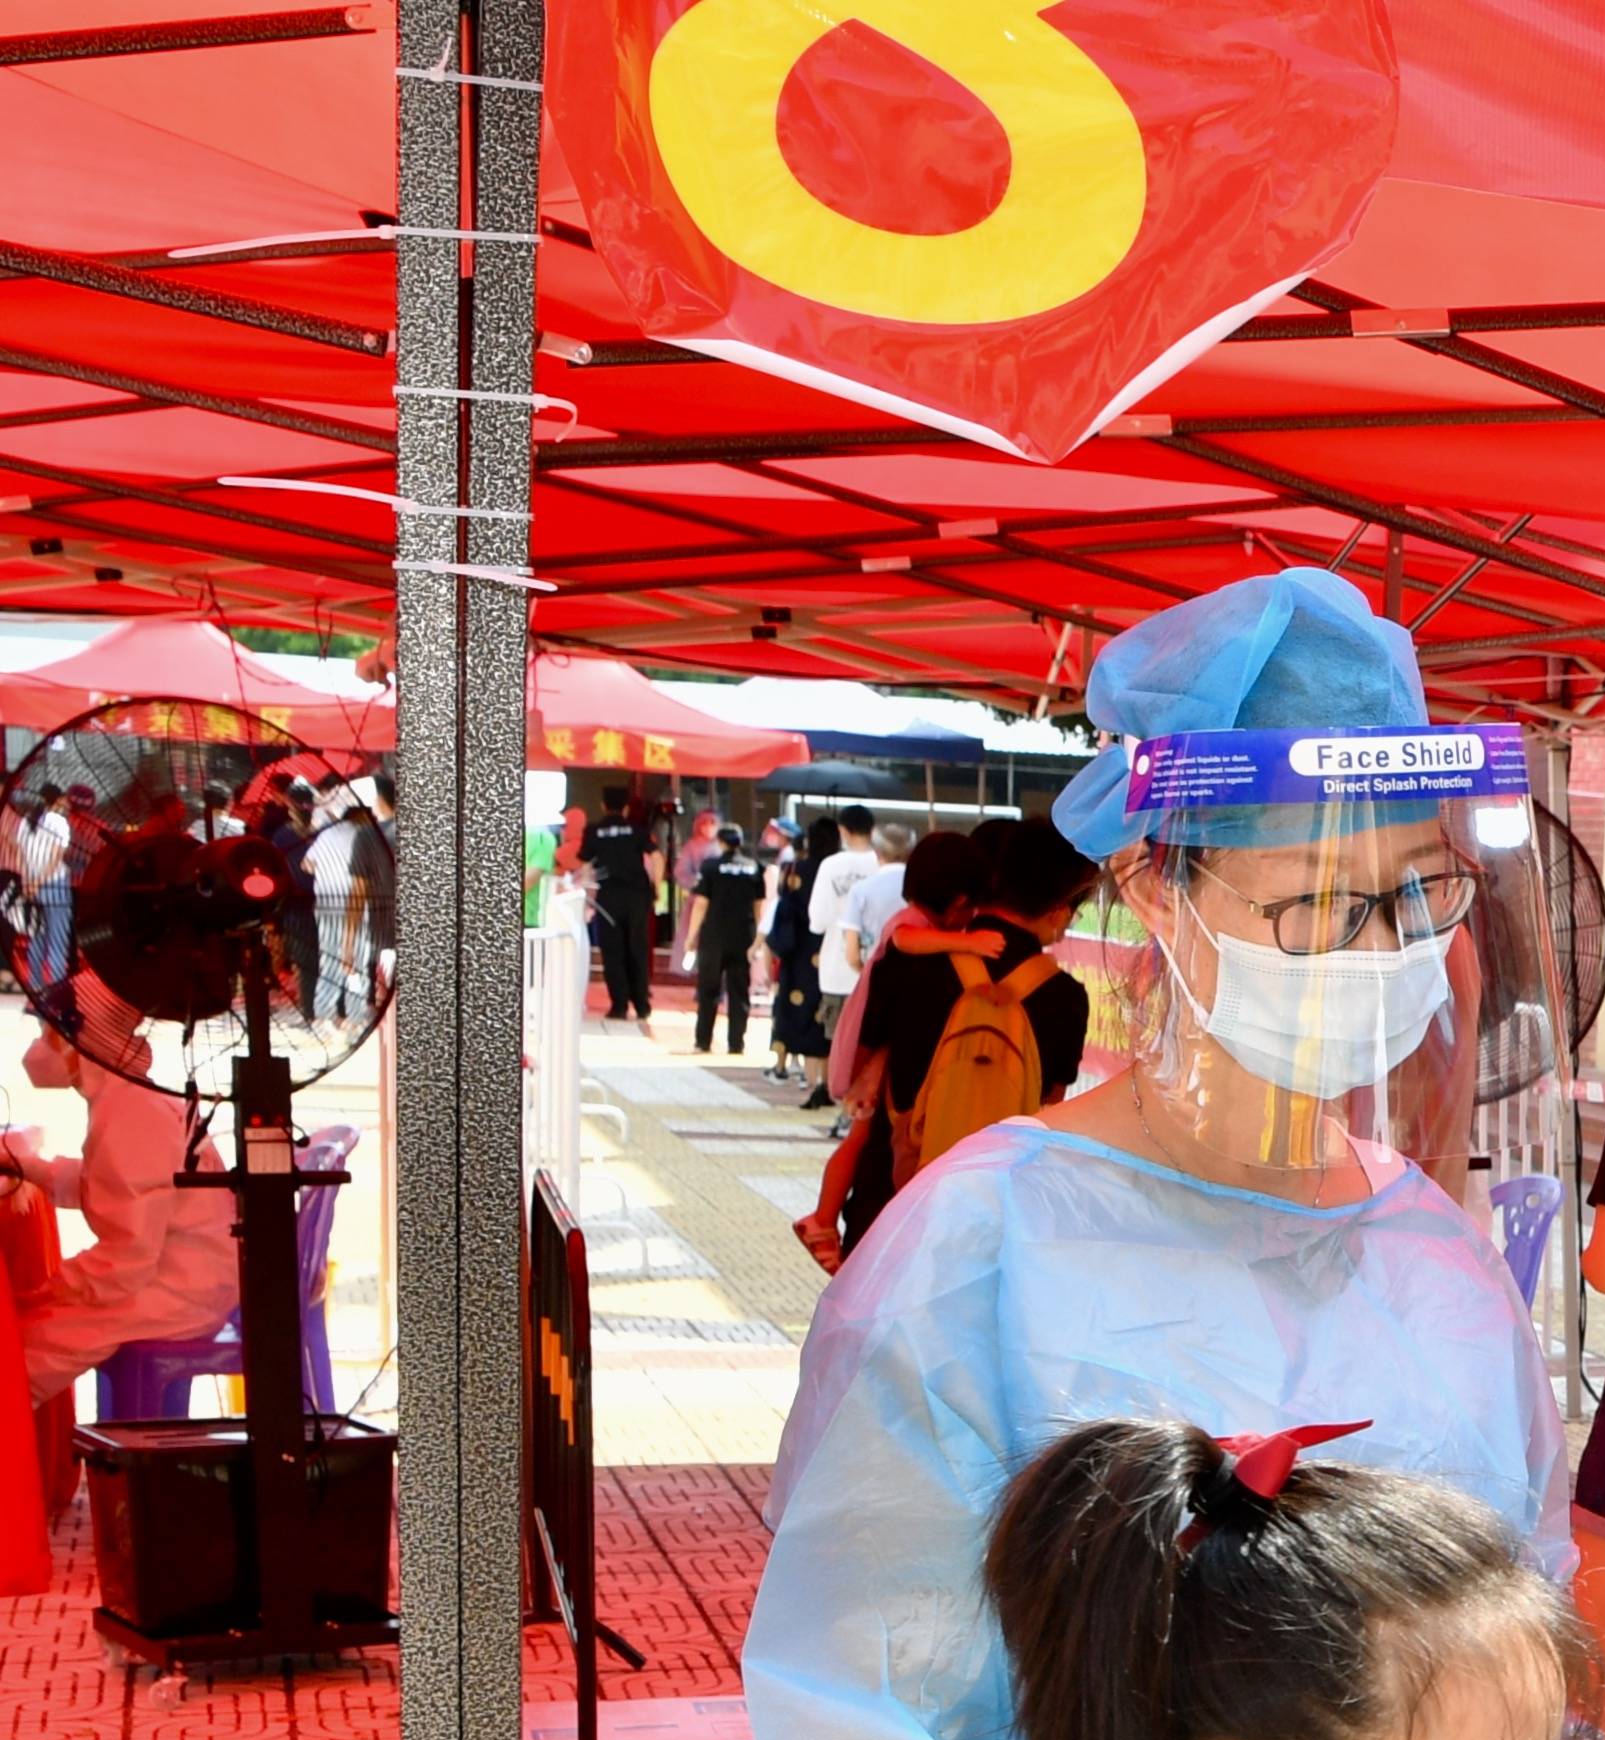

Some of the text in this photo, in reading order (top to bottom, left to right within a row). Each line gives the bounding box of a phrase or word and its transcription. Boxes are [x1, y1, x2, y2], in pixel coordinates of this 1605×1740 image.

[1317, 745, 1390, 769] Face
[1402, 740, 1472, 767] Shield
[1323, 775, 1473, 794] Direct Splash Protection
